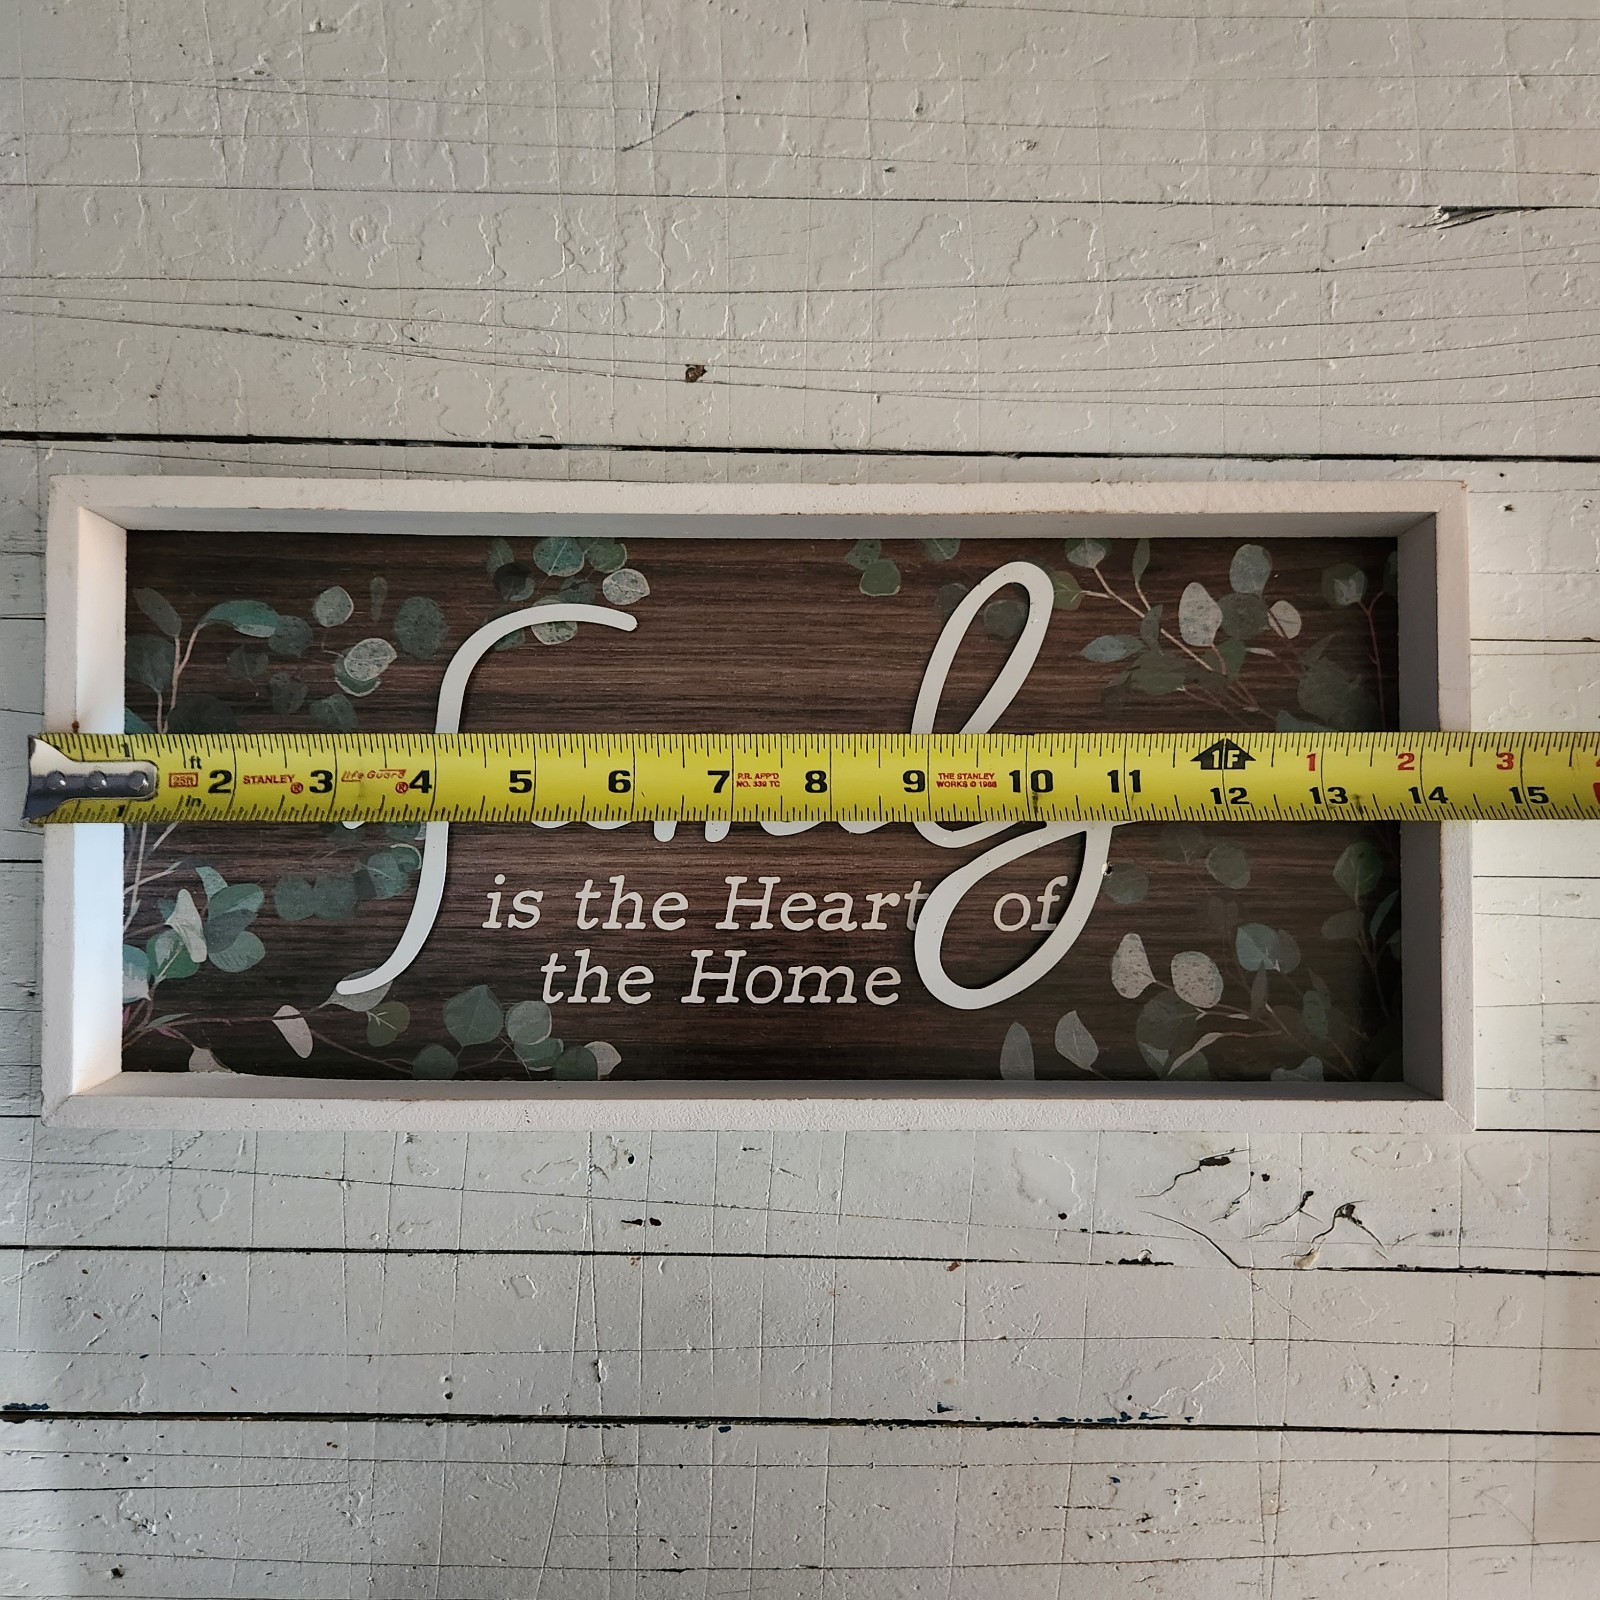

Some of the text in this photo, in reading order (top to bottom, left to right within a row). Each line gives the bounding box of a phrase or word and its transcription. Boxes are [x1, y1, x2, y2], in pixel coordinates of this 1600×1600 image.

[188, 755, 202, 770] ft
[1306, 753, 1316, 772] 1
[1397, 753, 1416, 771] 2
[1495, 752, 1515, 771] 3
[208, 769, 233, 794] 2
[243, 773, 296, 786] STANLEY
[309, 769, 333, 794] 3
[408, 769, 433, 794] 4
[508, 769, 533, 794] 5
[607, 769, 632, 794] 6
[706, 769, 731, 794] 7
[804, 769, 828, 794] 8
[902, 769, 927, 794] 9
[936, 780, 968, 788] WORKS
[937, 772, 995, 780] THE STANLEY
[1008, 769, 1054, 794] 10
[1107, 769, 1141, 793] 11
[1209, 787, 1250, 805] 12
[1308, 786, 1349, 805] 13
[1408, 786, 1449, 804] 14
[1508, 786, 1549, 804] 15
[481, 873, 544, 930] is
[574, 874, 690, 932] the
[992, 875, 1069, 932] of
[540, 948, 902, 1006] the Home
